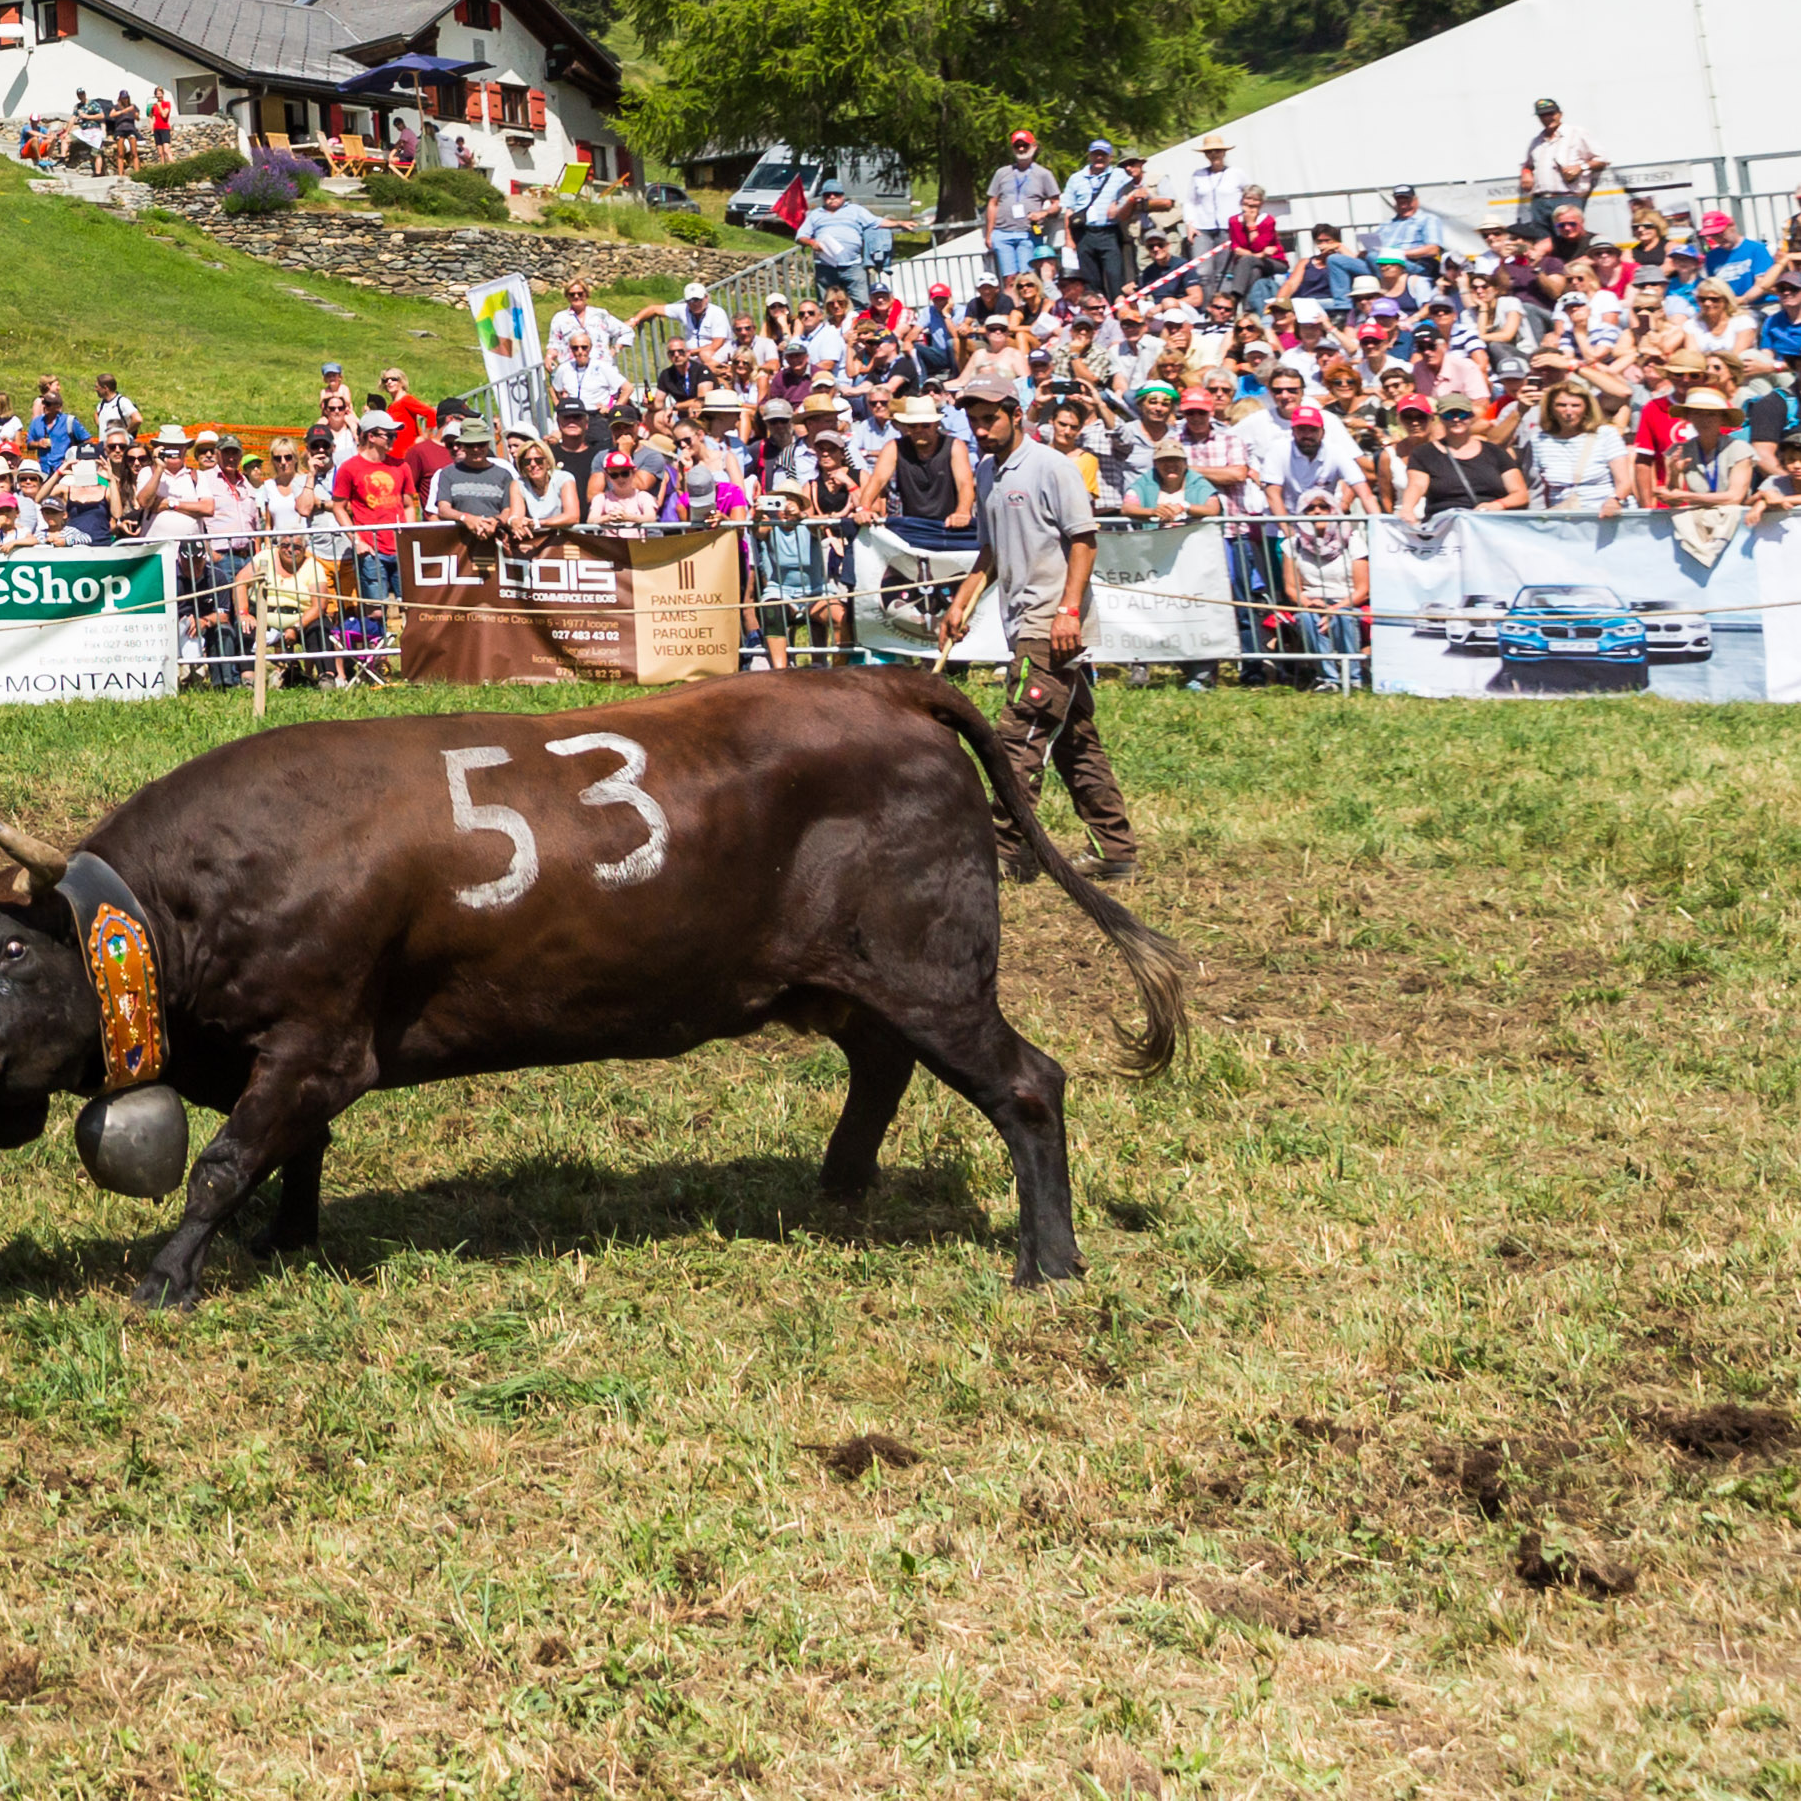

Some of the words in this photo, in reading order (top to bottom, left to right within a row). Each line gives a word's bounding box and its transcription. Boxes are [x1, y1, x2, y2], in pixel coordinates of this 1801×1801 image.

[532, 592, 582, 602] COMMERCE
[583, 593, 595, 603] DE
[596, 594, 617, 603] BOIS
[651, 593, 722, 605] PANNEAUX
[652, 610, 697, 622] LAMES
[552, 630, 570, 640] 027
[592, 631, 605, 640] 43
[606, 631, 620, 641] 02
[653, 627, 714, 639] PARQUET
[653, 645, 694, 656] VIEUX
[698, 643, 728, 655] BOIS
[440, 732, 670, 911] 53
